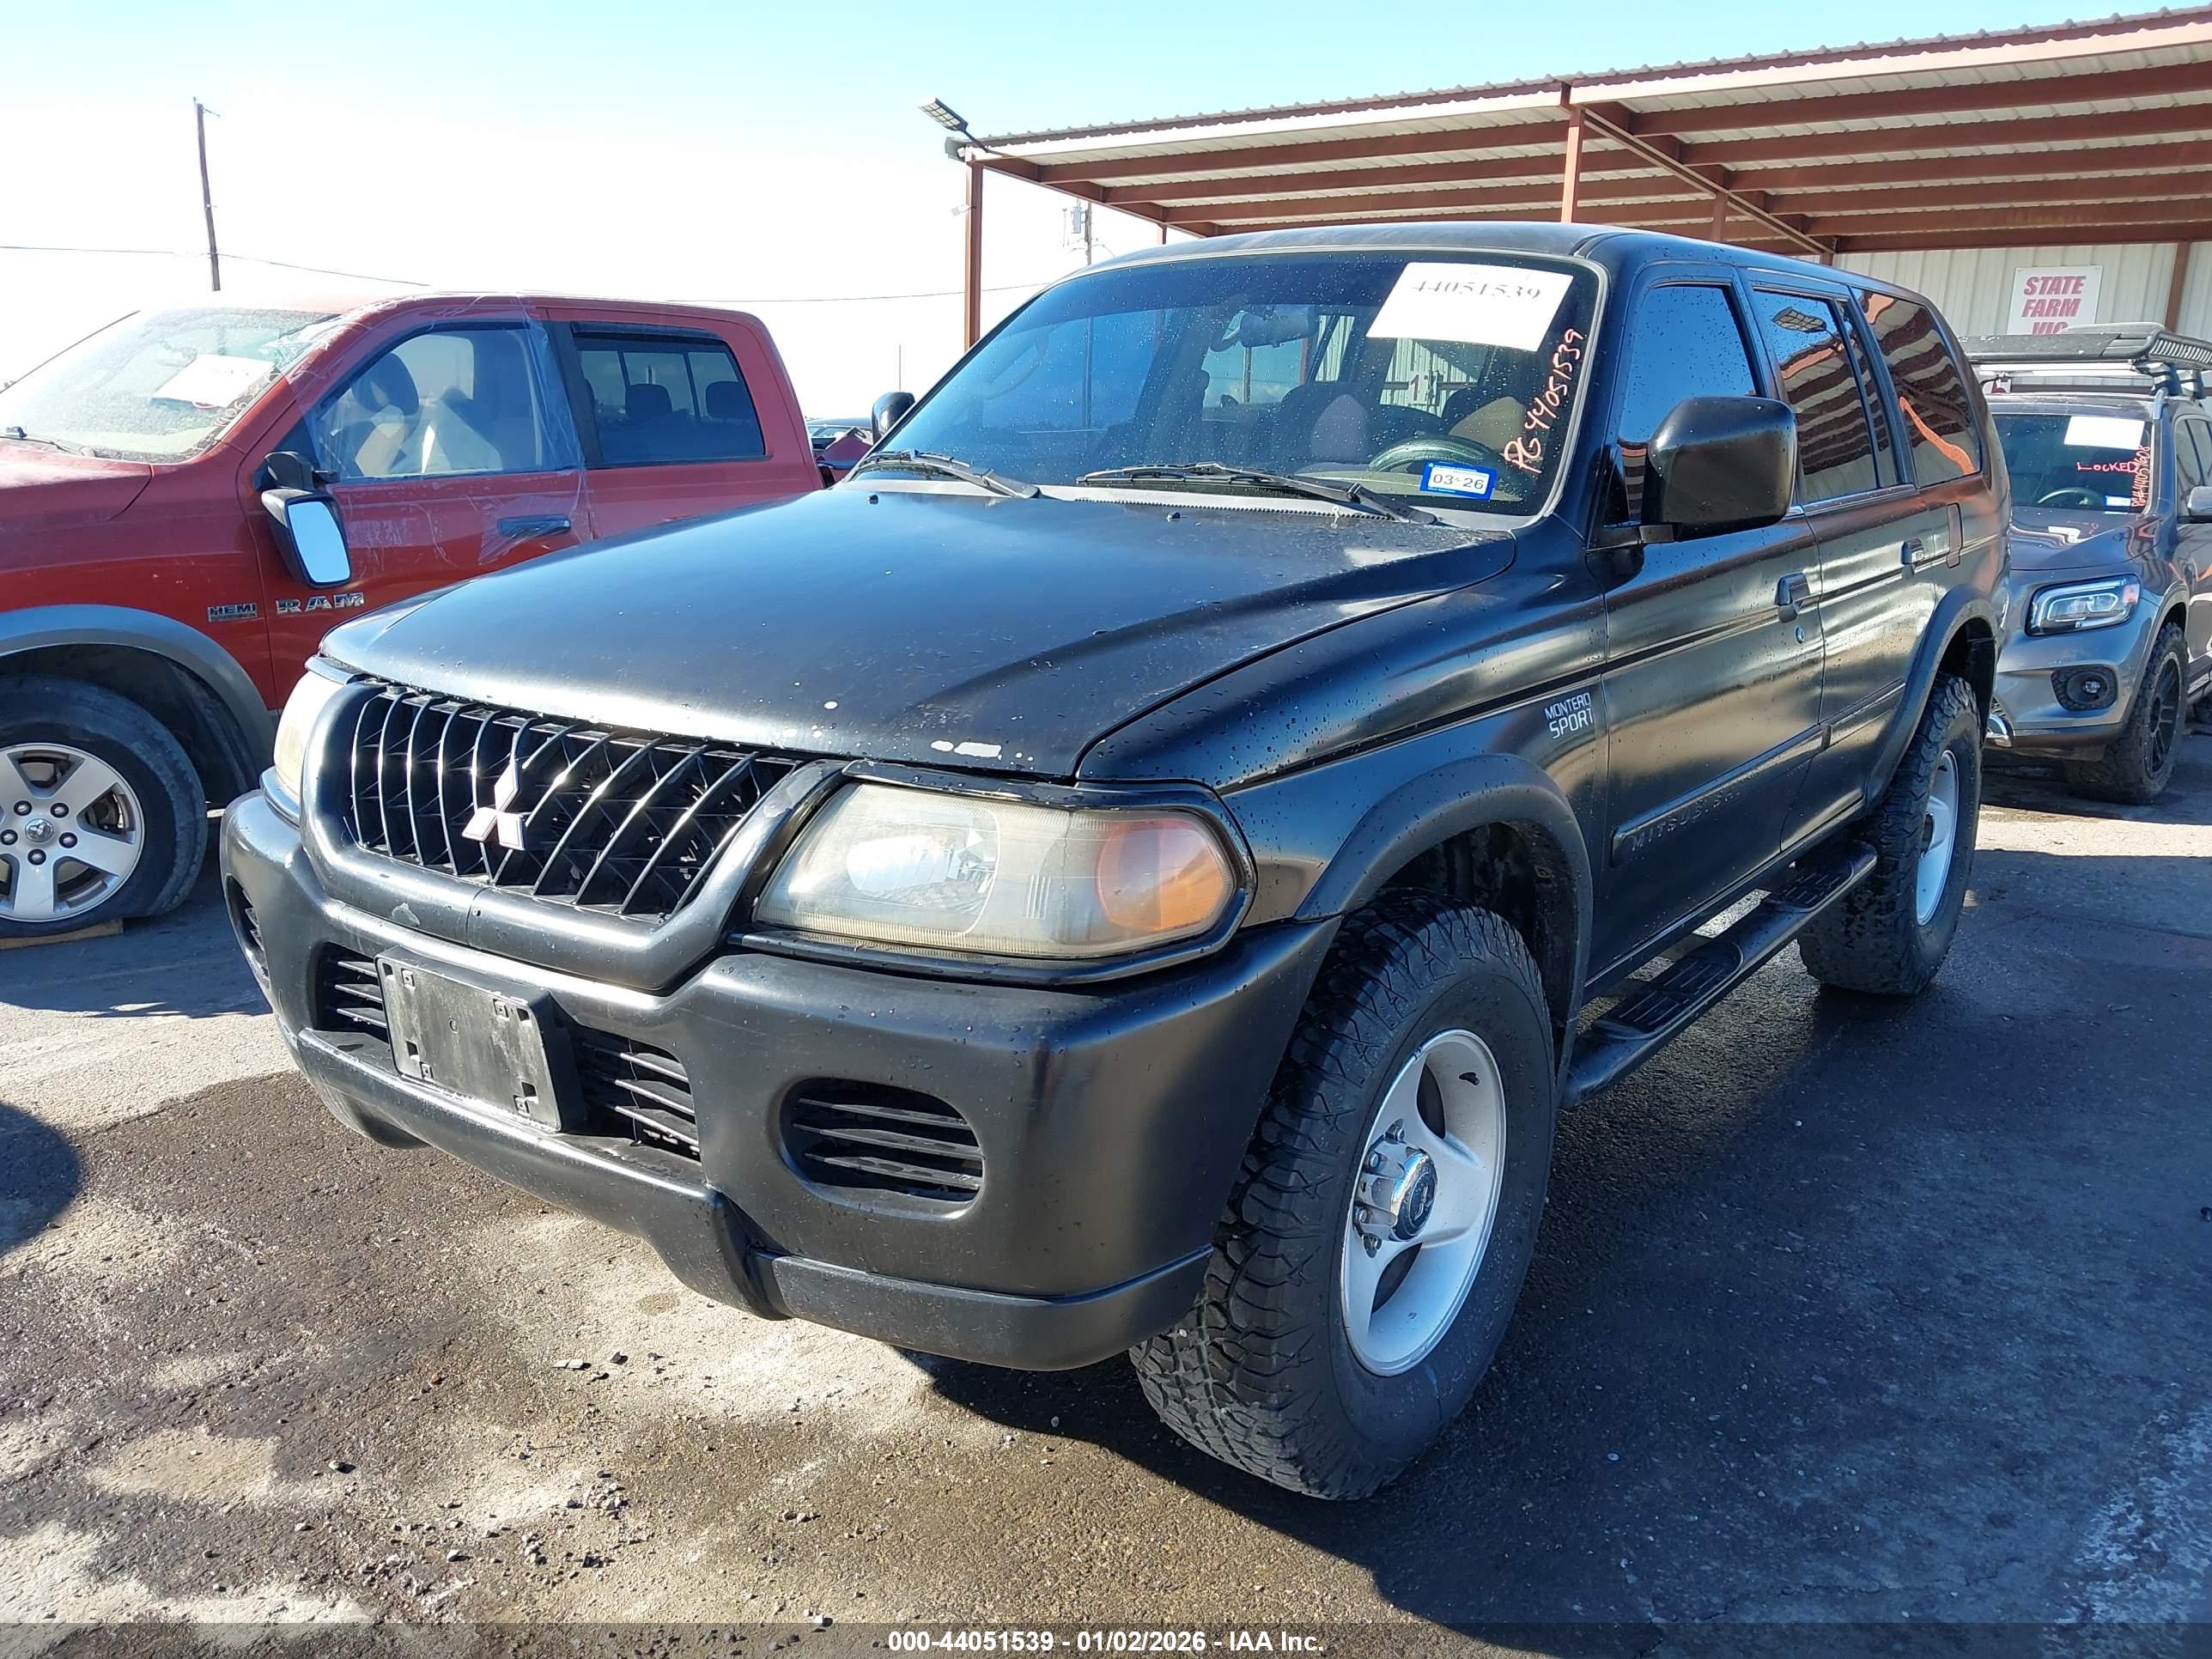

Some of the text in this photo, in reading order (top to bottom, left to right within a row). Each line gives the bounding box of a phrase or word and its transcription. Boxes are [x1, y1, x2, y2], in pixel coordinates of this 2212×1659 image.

[1412, 281, 1541, 300] 44051539
[2023, 275, 2087, 296] STATE
[2021, 298, 2082, 318] FARM
[1524, 328, 1584, 429] 44051539
[209, 604, 257, 616] HEMI
[276, 592, 365, 616] RAM
[1544, 692, 1592, 721] MONTERO
[1549, 708, 1594, 739] SPORT
